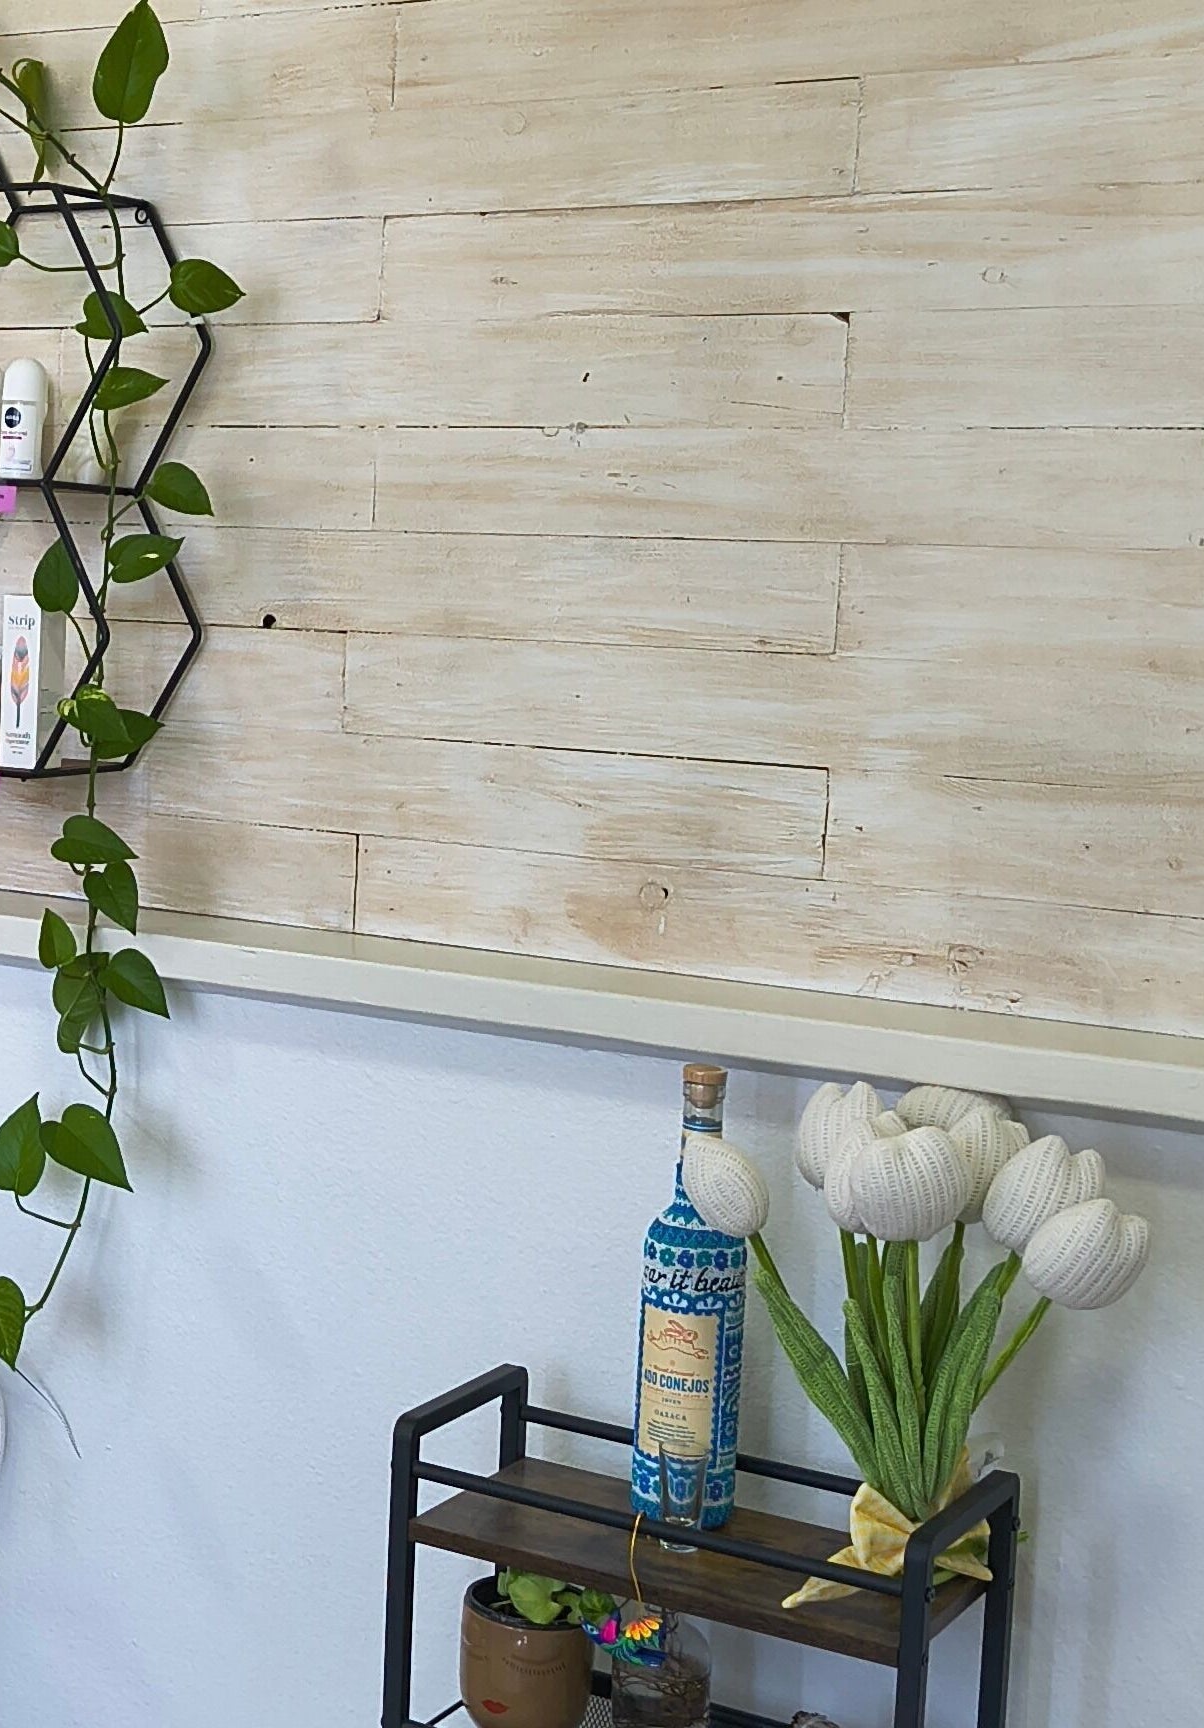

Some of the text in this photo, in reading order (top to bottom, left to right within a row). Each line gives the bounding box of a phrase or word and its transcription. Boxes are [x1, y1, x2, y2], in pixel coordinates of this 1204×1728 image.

[670, 1269, 693, 1291] it
[659, 1373, 710, 1394] CONEJOS
[654, 1409, 687, 1421] OAXACA
